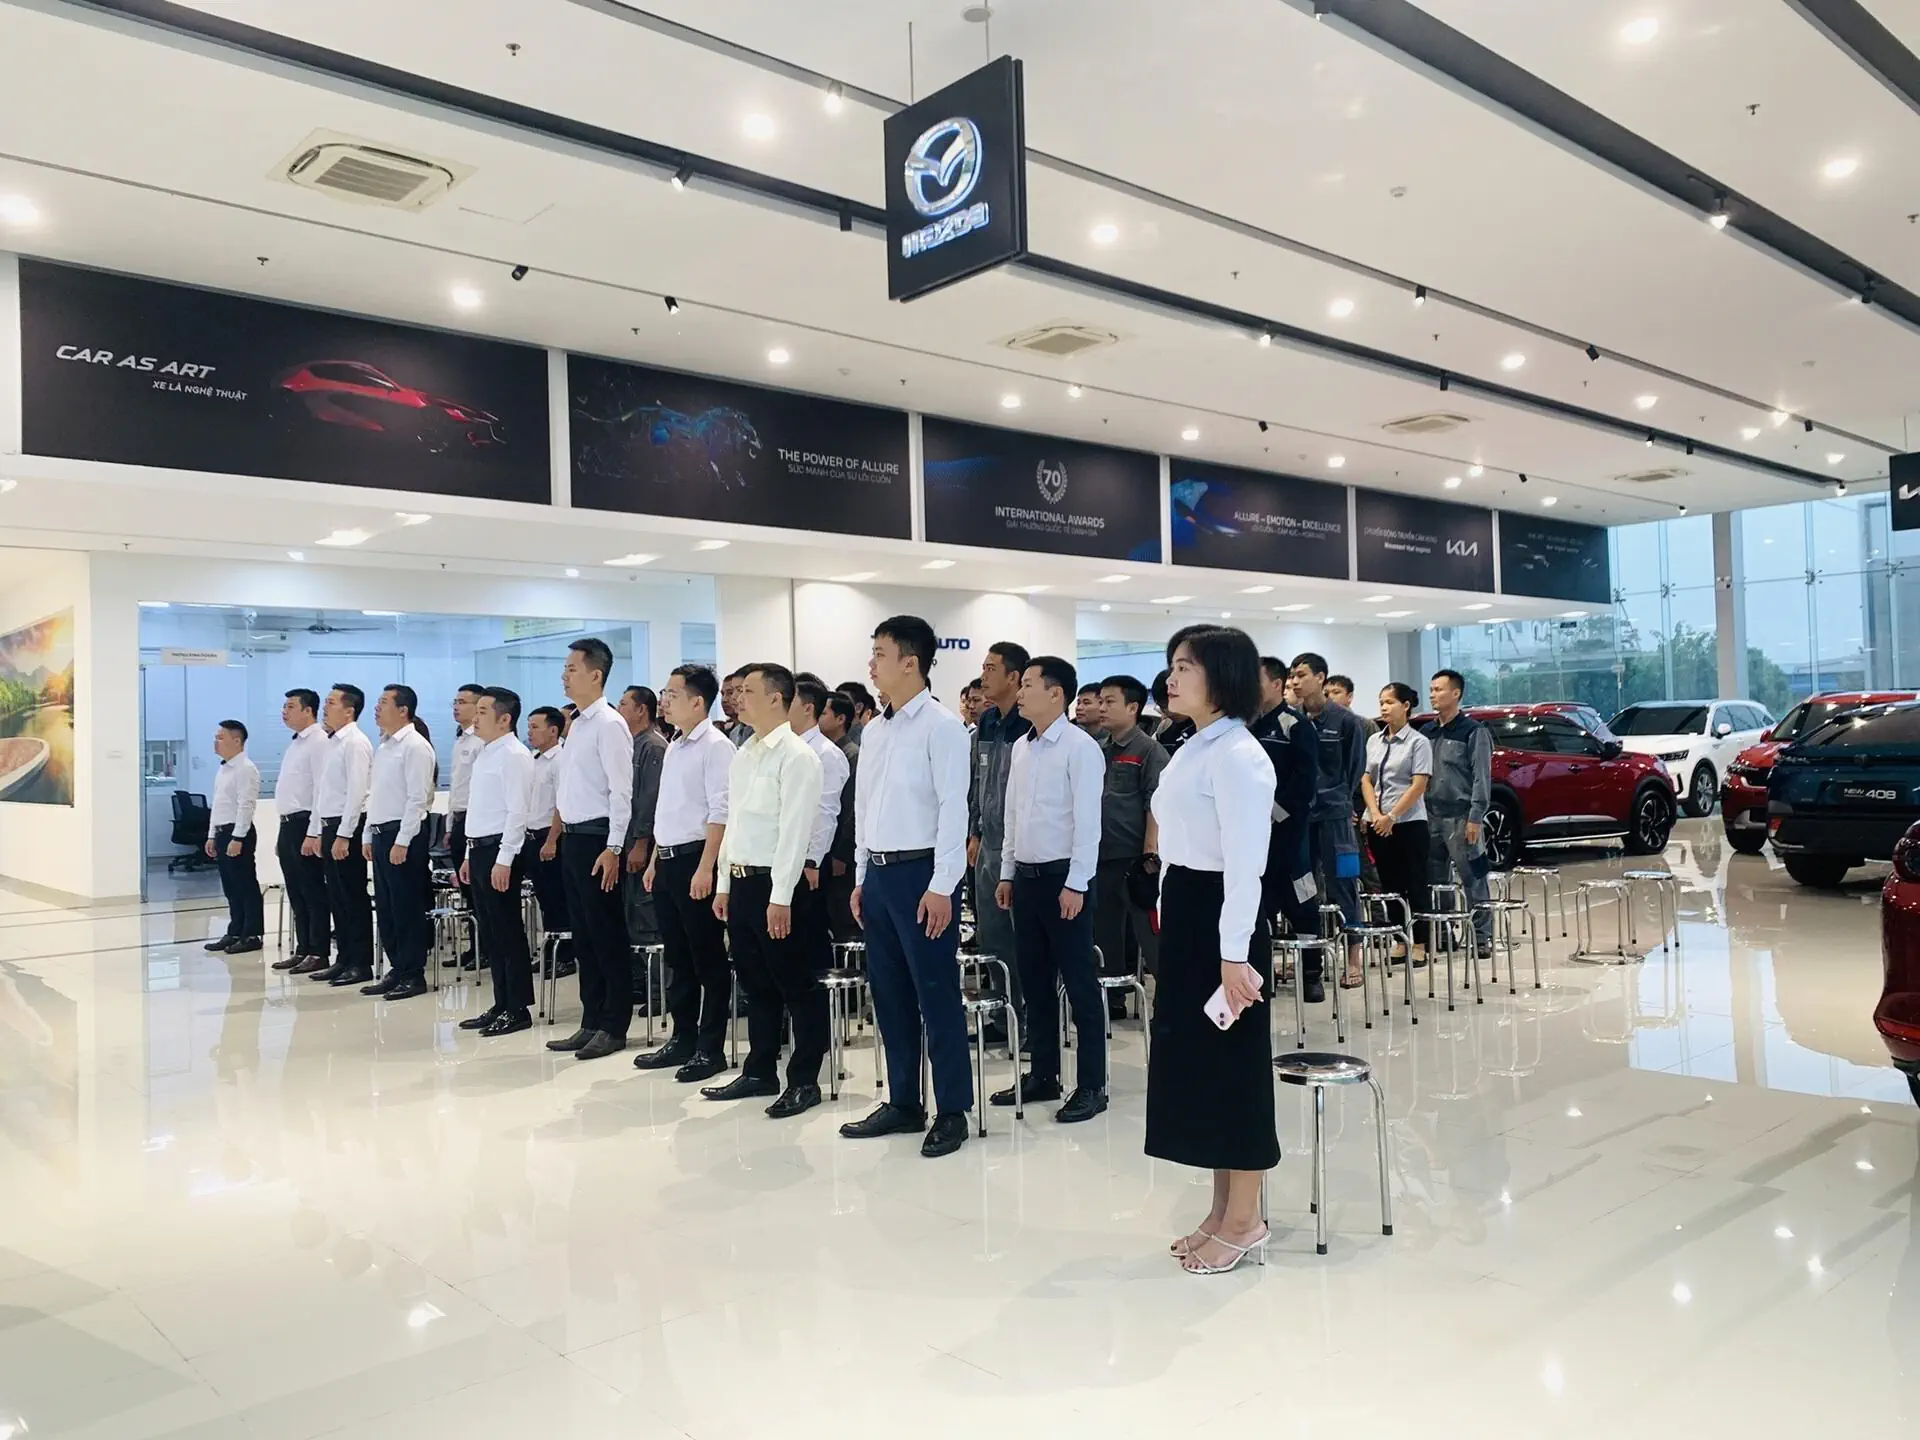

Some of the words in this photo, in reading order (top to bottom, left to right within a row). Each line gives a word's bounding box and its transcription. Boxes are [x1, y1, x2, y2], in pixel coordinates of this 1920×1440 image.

[56, 345, 114, 366] CAR
[116, 355, 158, 371] AS
[159, 361, 216, 379] ART
[152, 380, 167, 390] XE
[184, 385, 213, 397] NGHỆ
[215, 389, 248, 402] THUẬT
[778, 448, 800, 462] THE
[802, 452, 843, 468] POWER
[845, 458, 859, 469] OF
[861, 460, 899, 475] ALLURE
[1043, 469, 1061, 487] 70
[995, 506, 1066, 524] INTERNATIONAL
[1067, 515, 1105, 529] AWARDS
[1234, 512, 1260, 523] ALLURE
[1266, 515, 1297, 528] EMOTION
[1302, 520, 1341, 534] EXCELLENCE
[1446, 540, 1478, 556] KIA
[1865, 789, 1897, 799] 408
